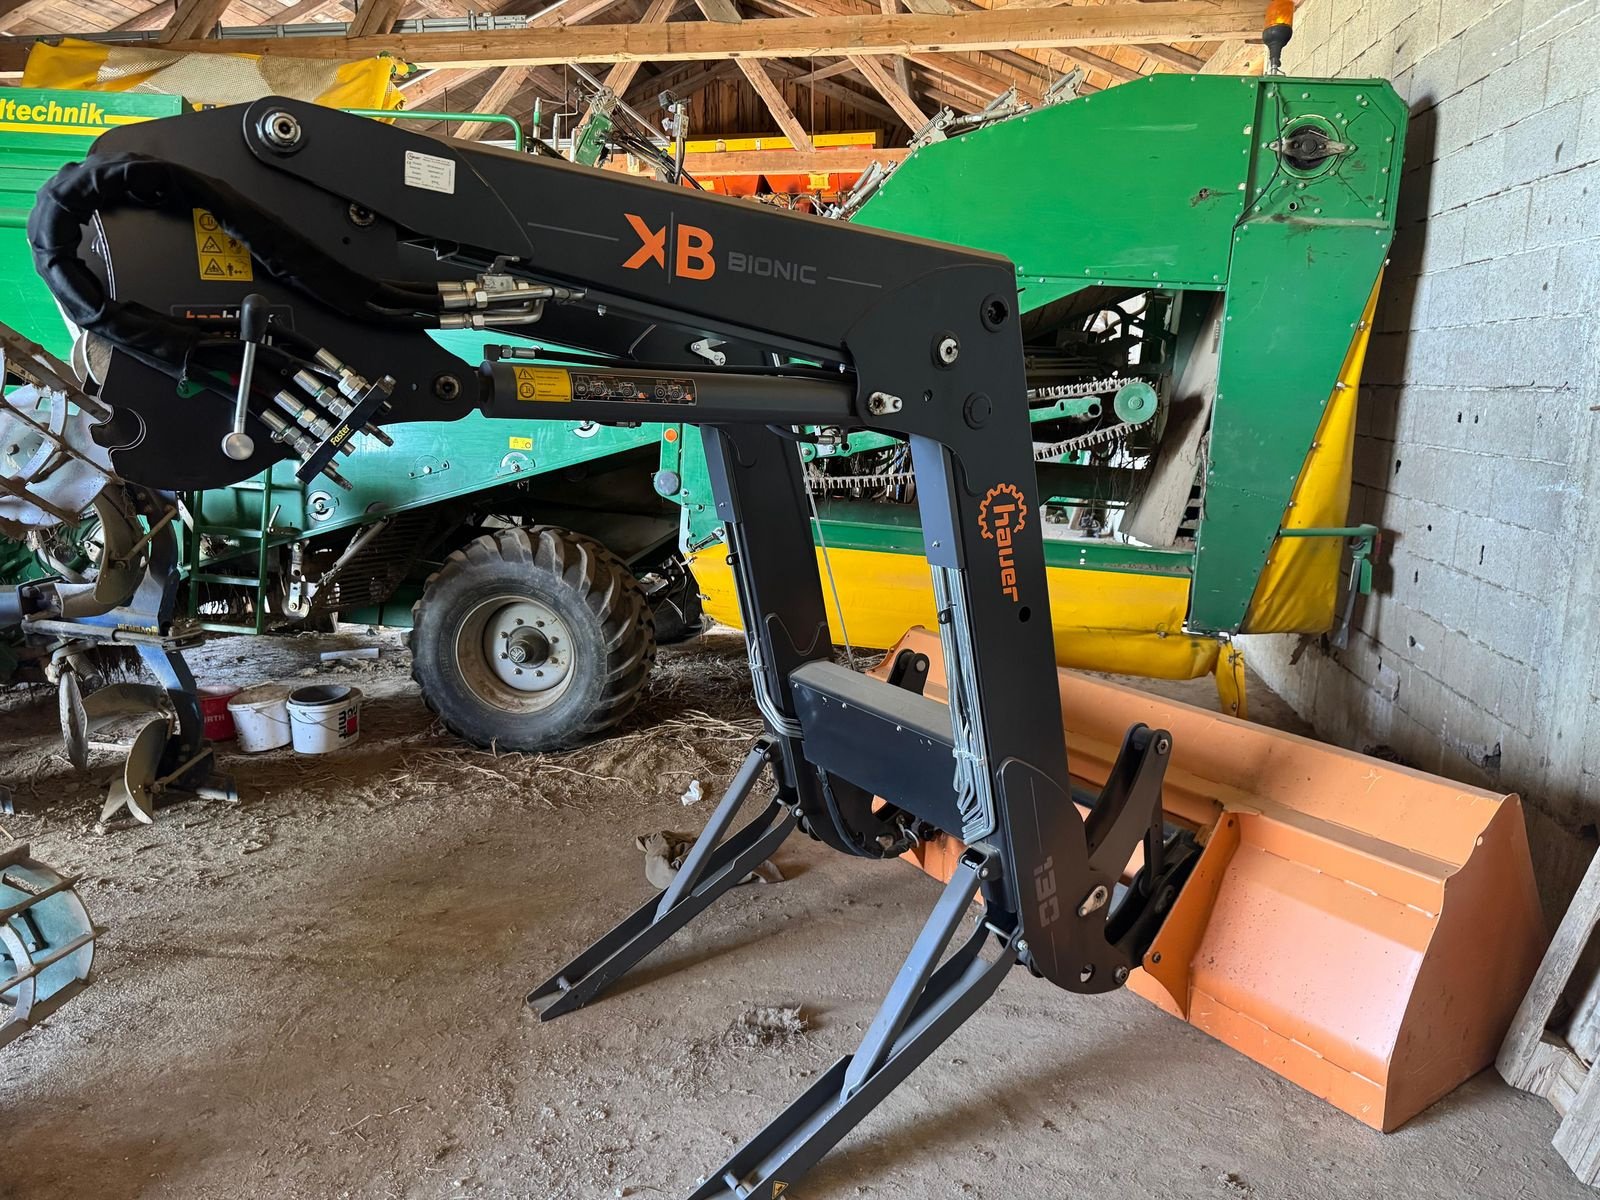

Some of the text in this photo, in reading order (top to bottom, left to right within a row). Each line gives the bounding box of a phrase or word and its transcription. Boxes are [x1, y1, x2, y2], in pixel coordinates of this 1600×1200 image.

[622, 213, 817, 285] XB BIONIC
[330, 423, 350, 446] Faster
[993, 503, 1019, 602] hauer
